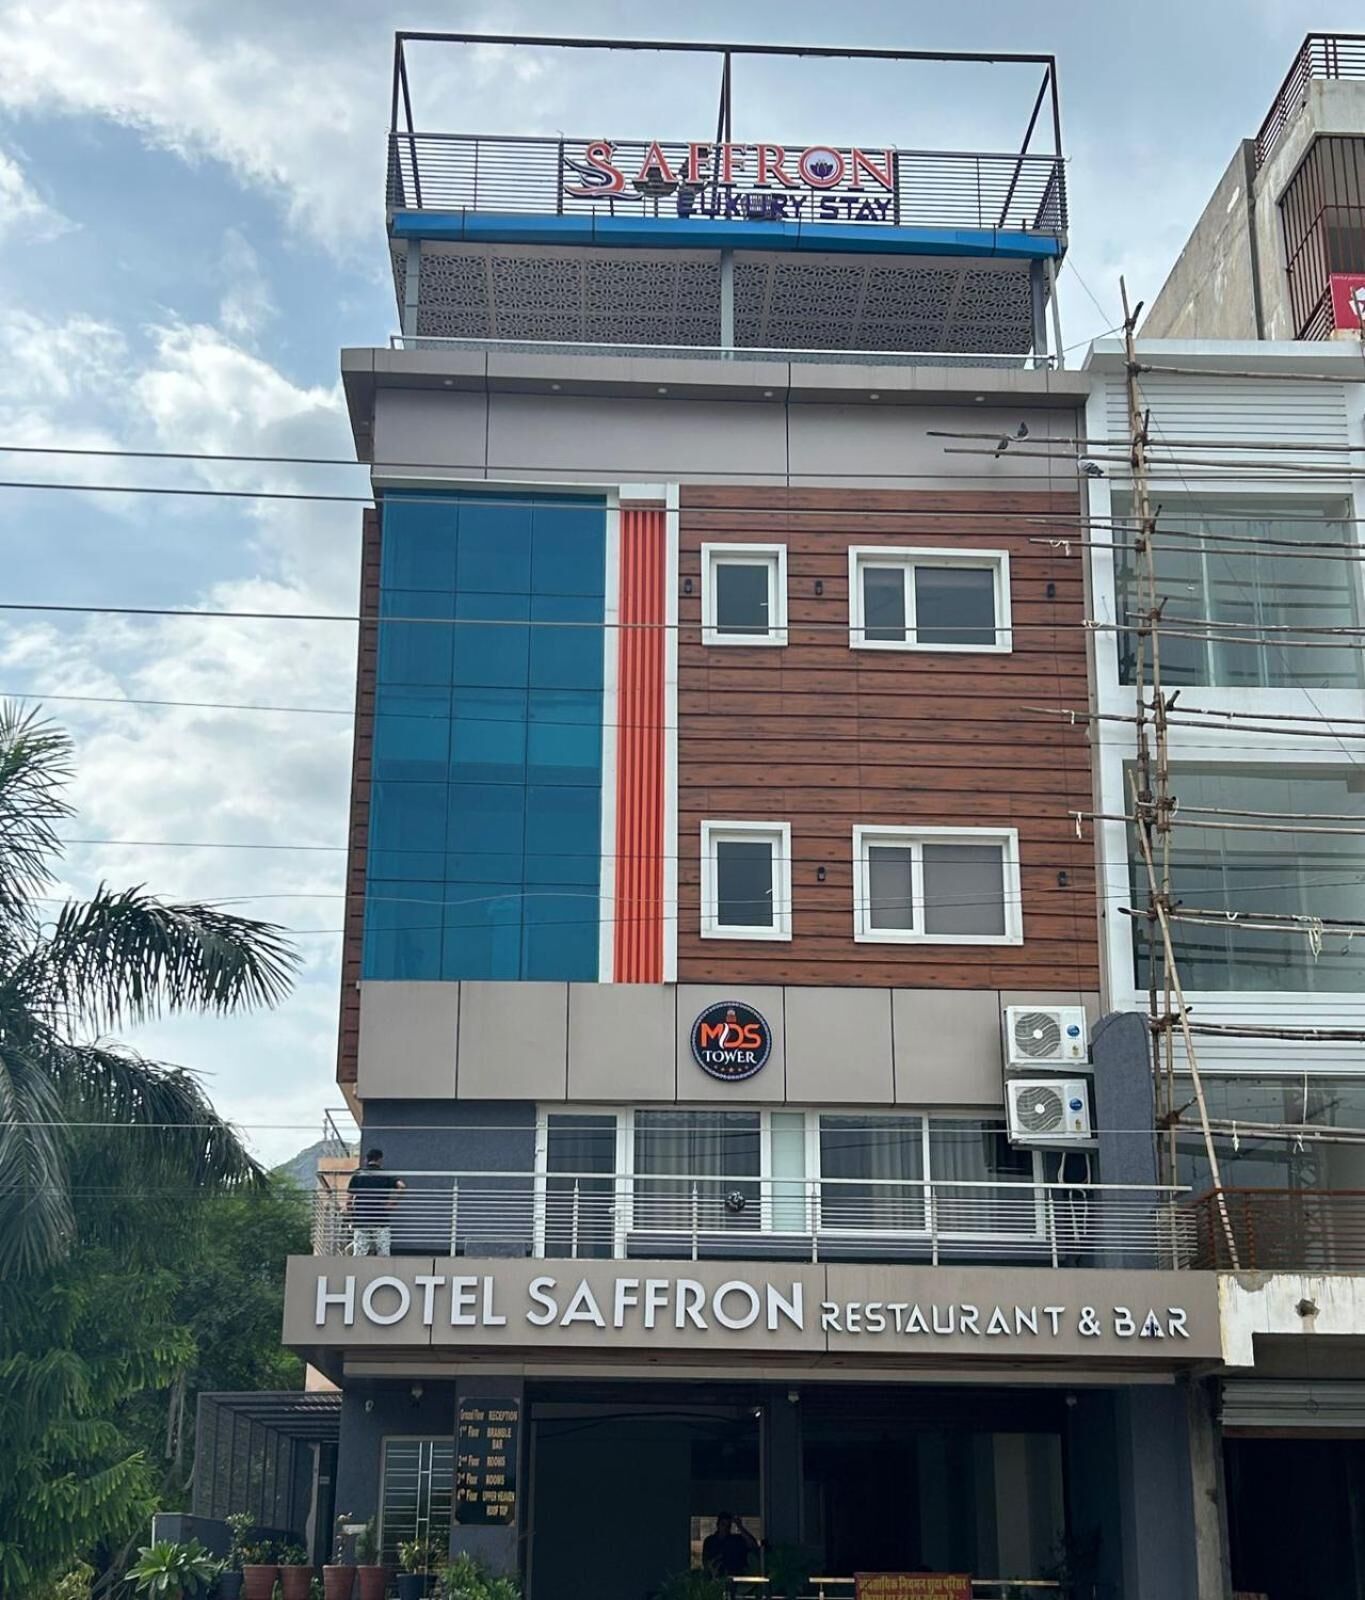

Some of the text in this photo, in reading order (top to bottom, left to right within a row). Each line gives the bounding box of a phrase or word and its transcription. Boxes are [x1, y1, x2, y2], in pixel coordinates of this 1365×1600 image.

[563, 139, 895, 200] SAFFRON
[820, 195, 892, 220] STAY
[701, 1022, 762, 1049] MDS
[702, 1048, 757, 1064] TOWER
[315, 1275, 1190, 1338] HOTEL SAFFRON RESTAURANT & BAR
[488, 1410, 518, 1421] RECEPTION
